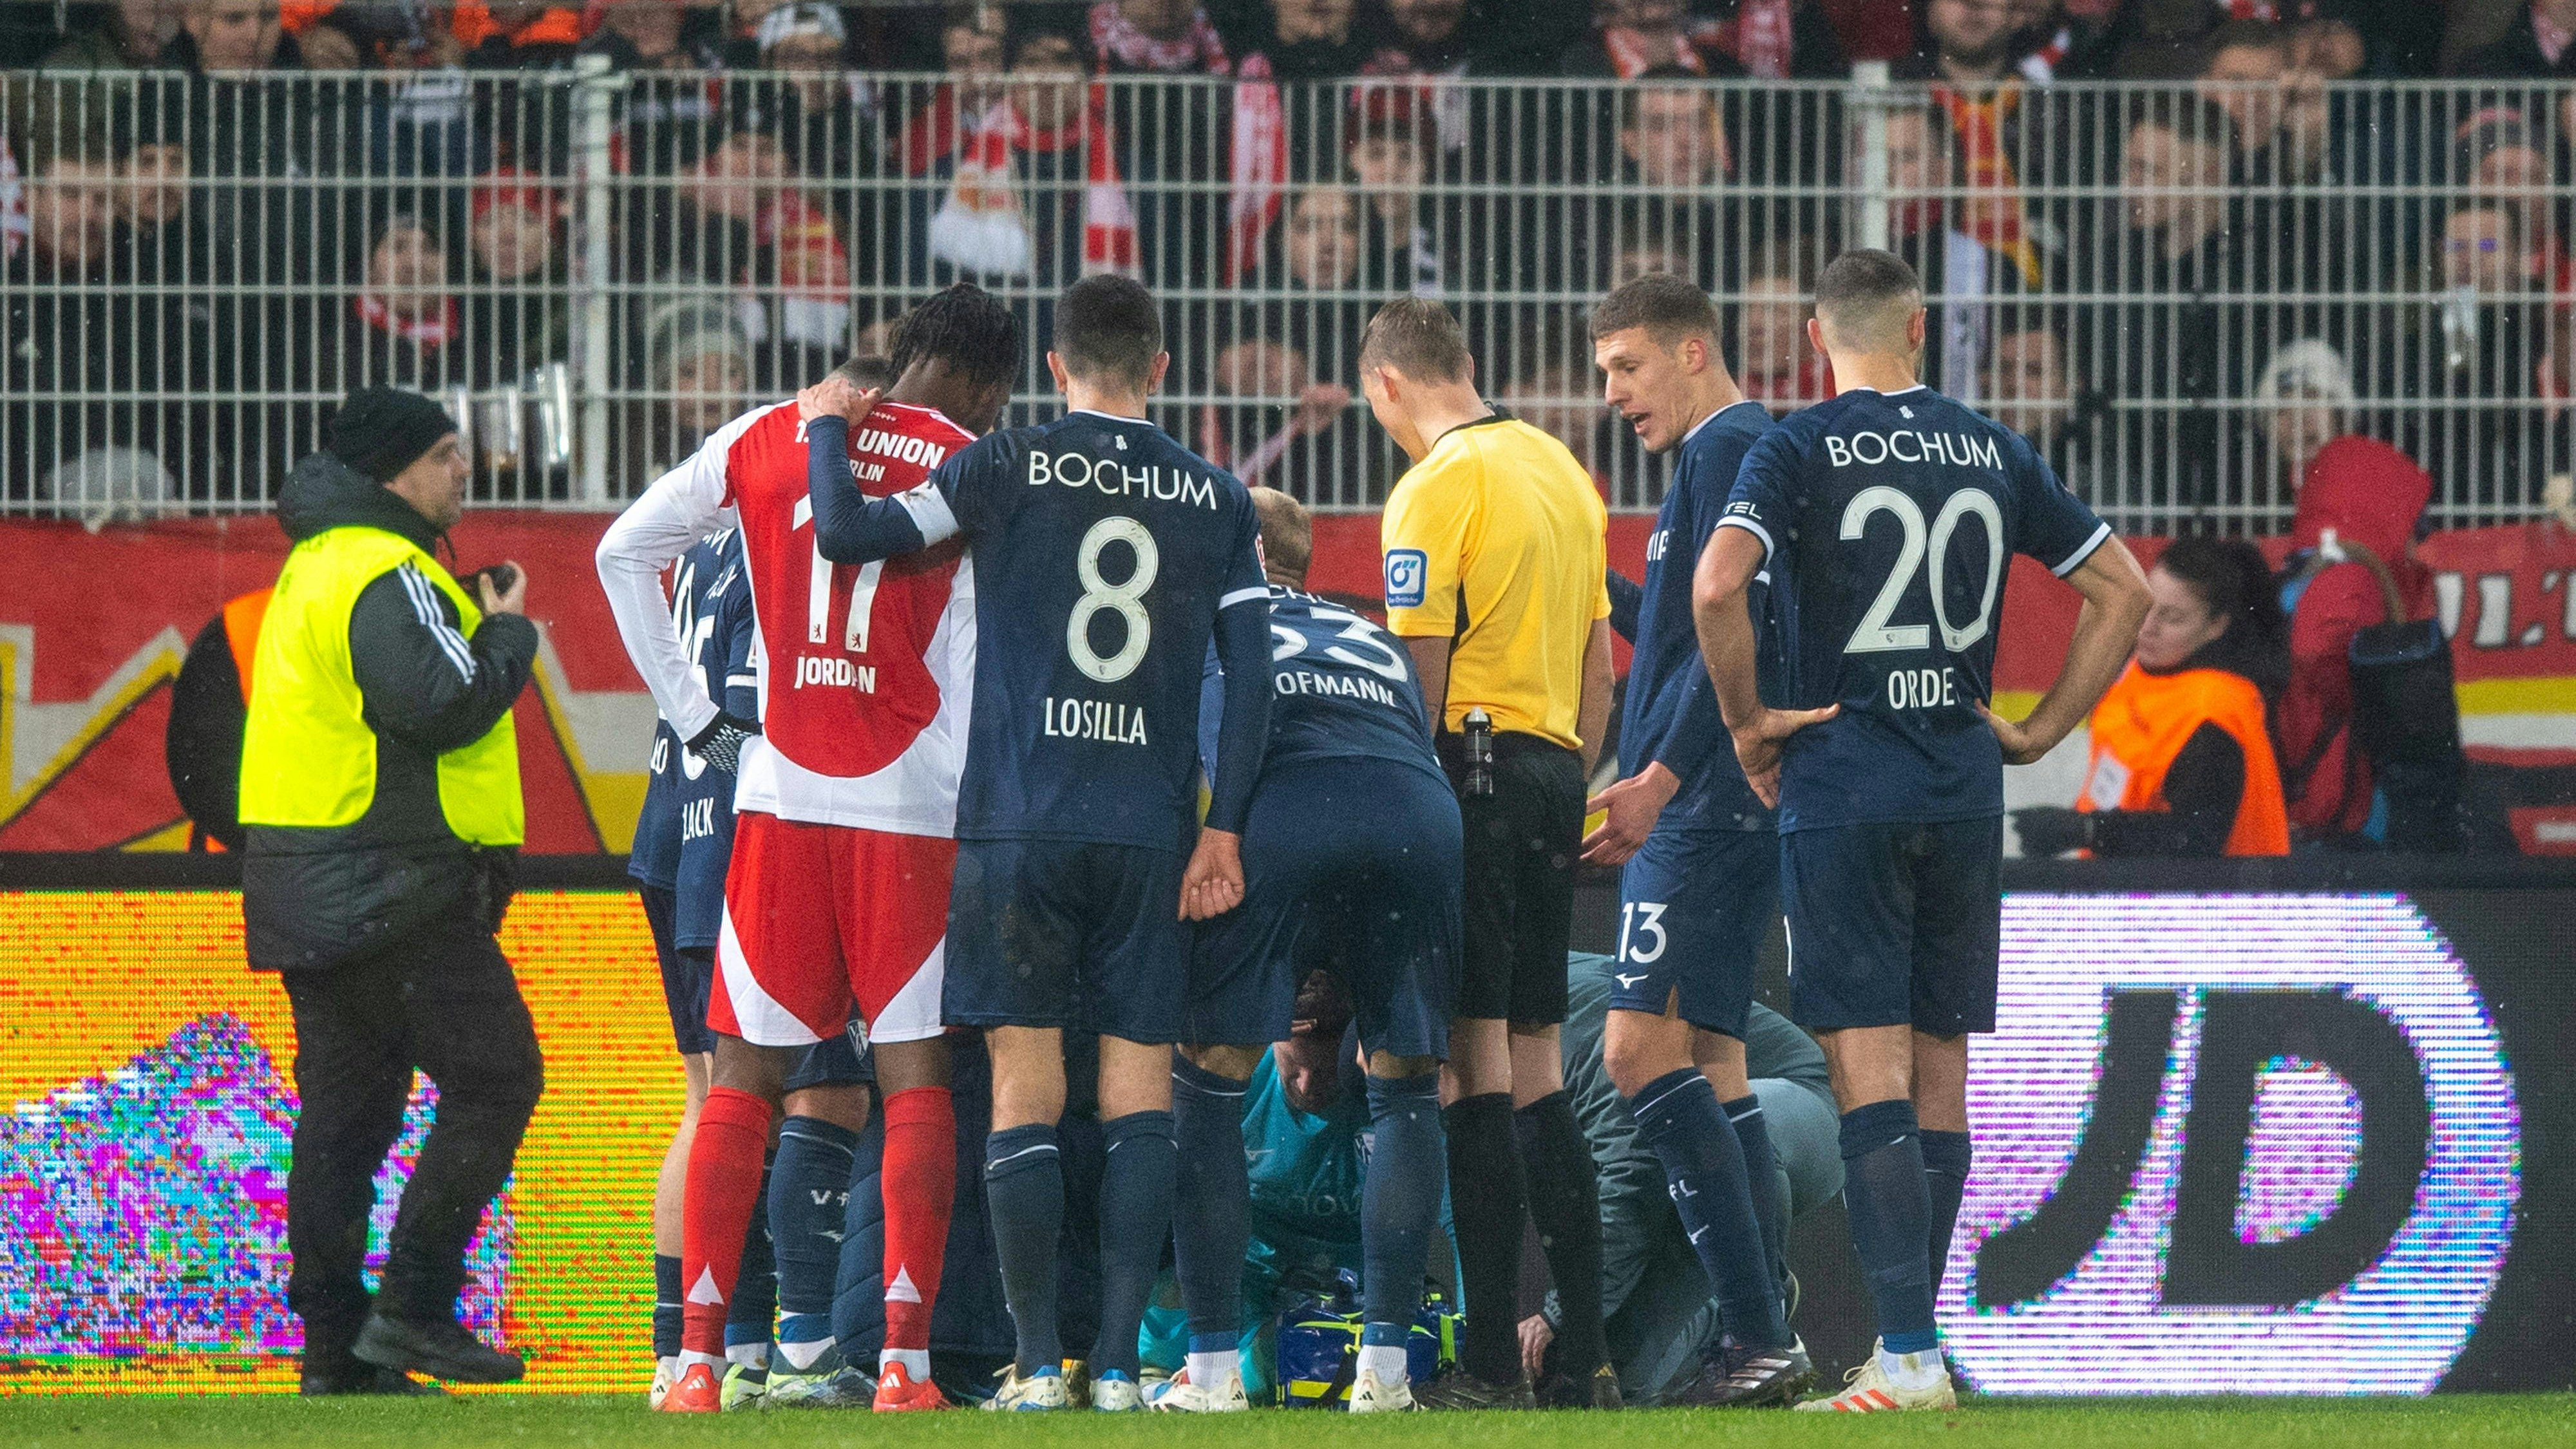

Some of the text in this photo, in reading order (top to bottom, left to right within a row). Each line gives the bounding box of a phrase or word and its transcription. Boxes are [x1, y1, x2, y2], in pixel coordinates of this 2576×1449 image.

[848, 459, 886, 482] RLIN
[857, 428, 947, 470] UNION
[1824, 430, 2003, 470] BOCHUM
[1028, 450, 1217, 511] BOCHUM
[1724, 501, 1763, 520] TEL
[1841, 486, 2004, 653] 20
[1066, 516, 1159, 683] 8
[1272, 671, 1400, 708] OFMANN
[1888, 667, 1962, 710] ORDE
[1044, 697, 1148, 746] LOSILLA
[1619, 902, 1669, 963] 13
[1973, 989, 2433, 1309] JD
